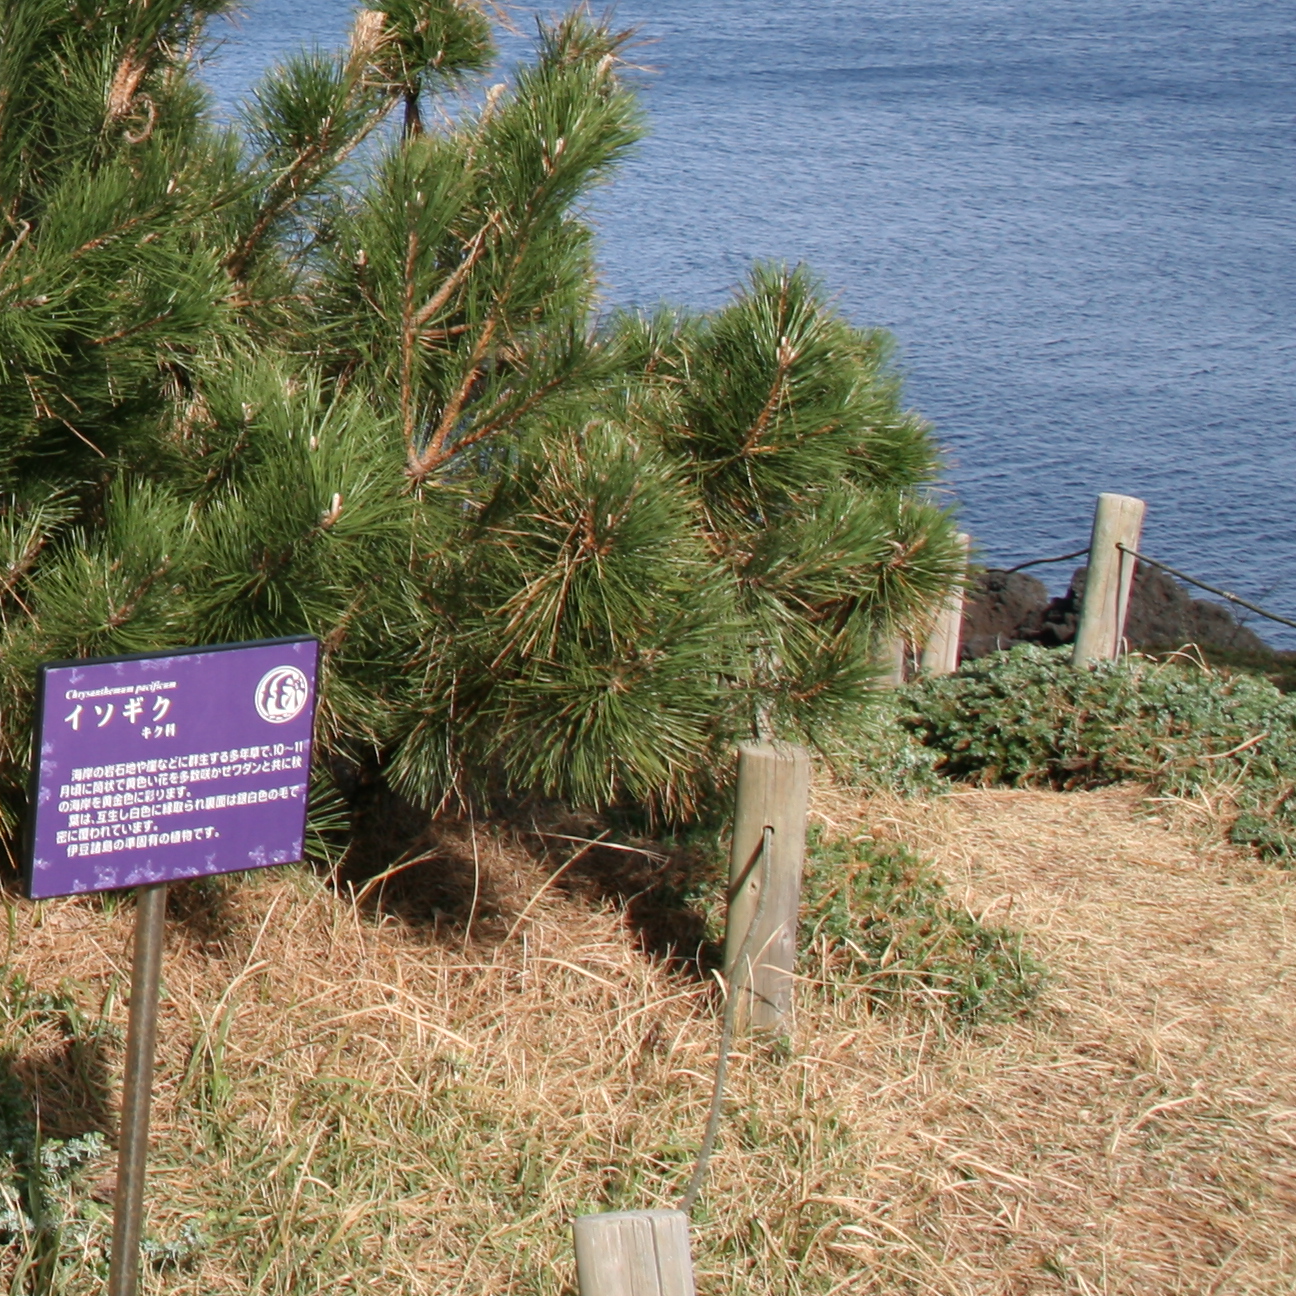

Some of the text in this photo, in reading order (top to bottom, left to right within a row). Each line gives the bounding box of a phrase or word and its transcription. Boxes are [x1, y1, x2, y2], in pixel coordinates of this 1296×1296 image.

[65, 680, 177, 700] Chrysanthemum pacificum
[64, 695, 171, 731] イソギク
[141, 722, 176, 739] キク科
[58, 786, 191, 813] の海岸を黄金色に彩ります。
[56, 820, 158, 844] 密に覆われています。
